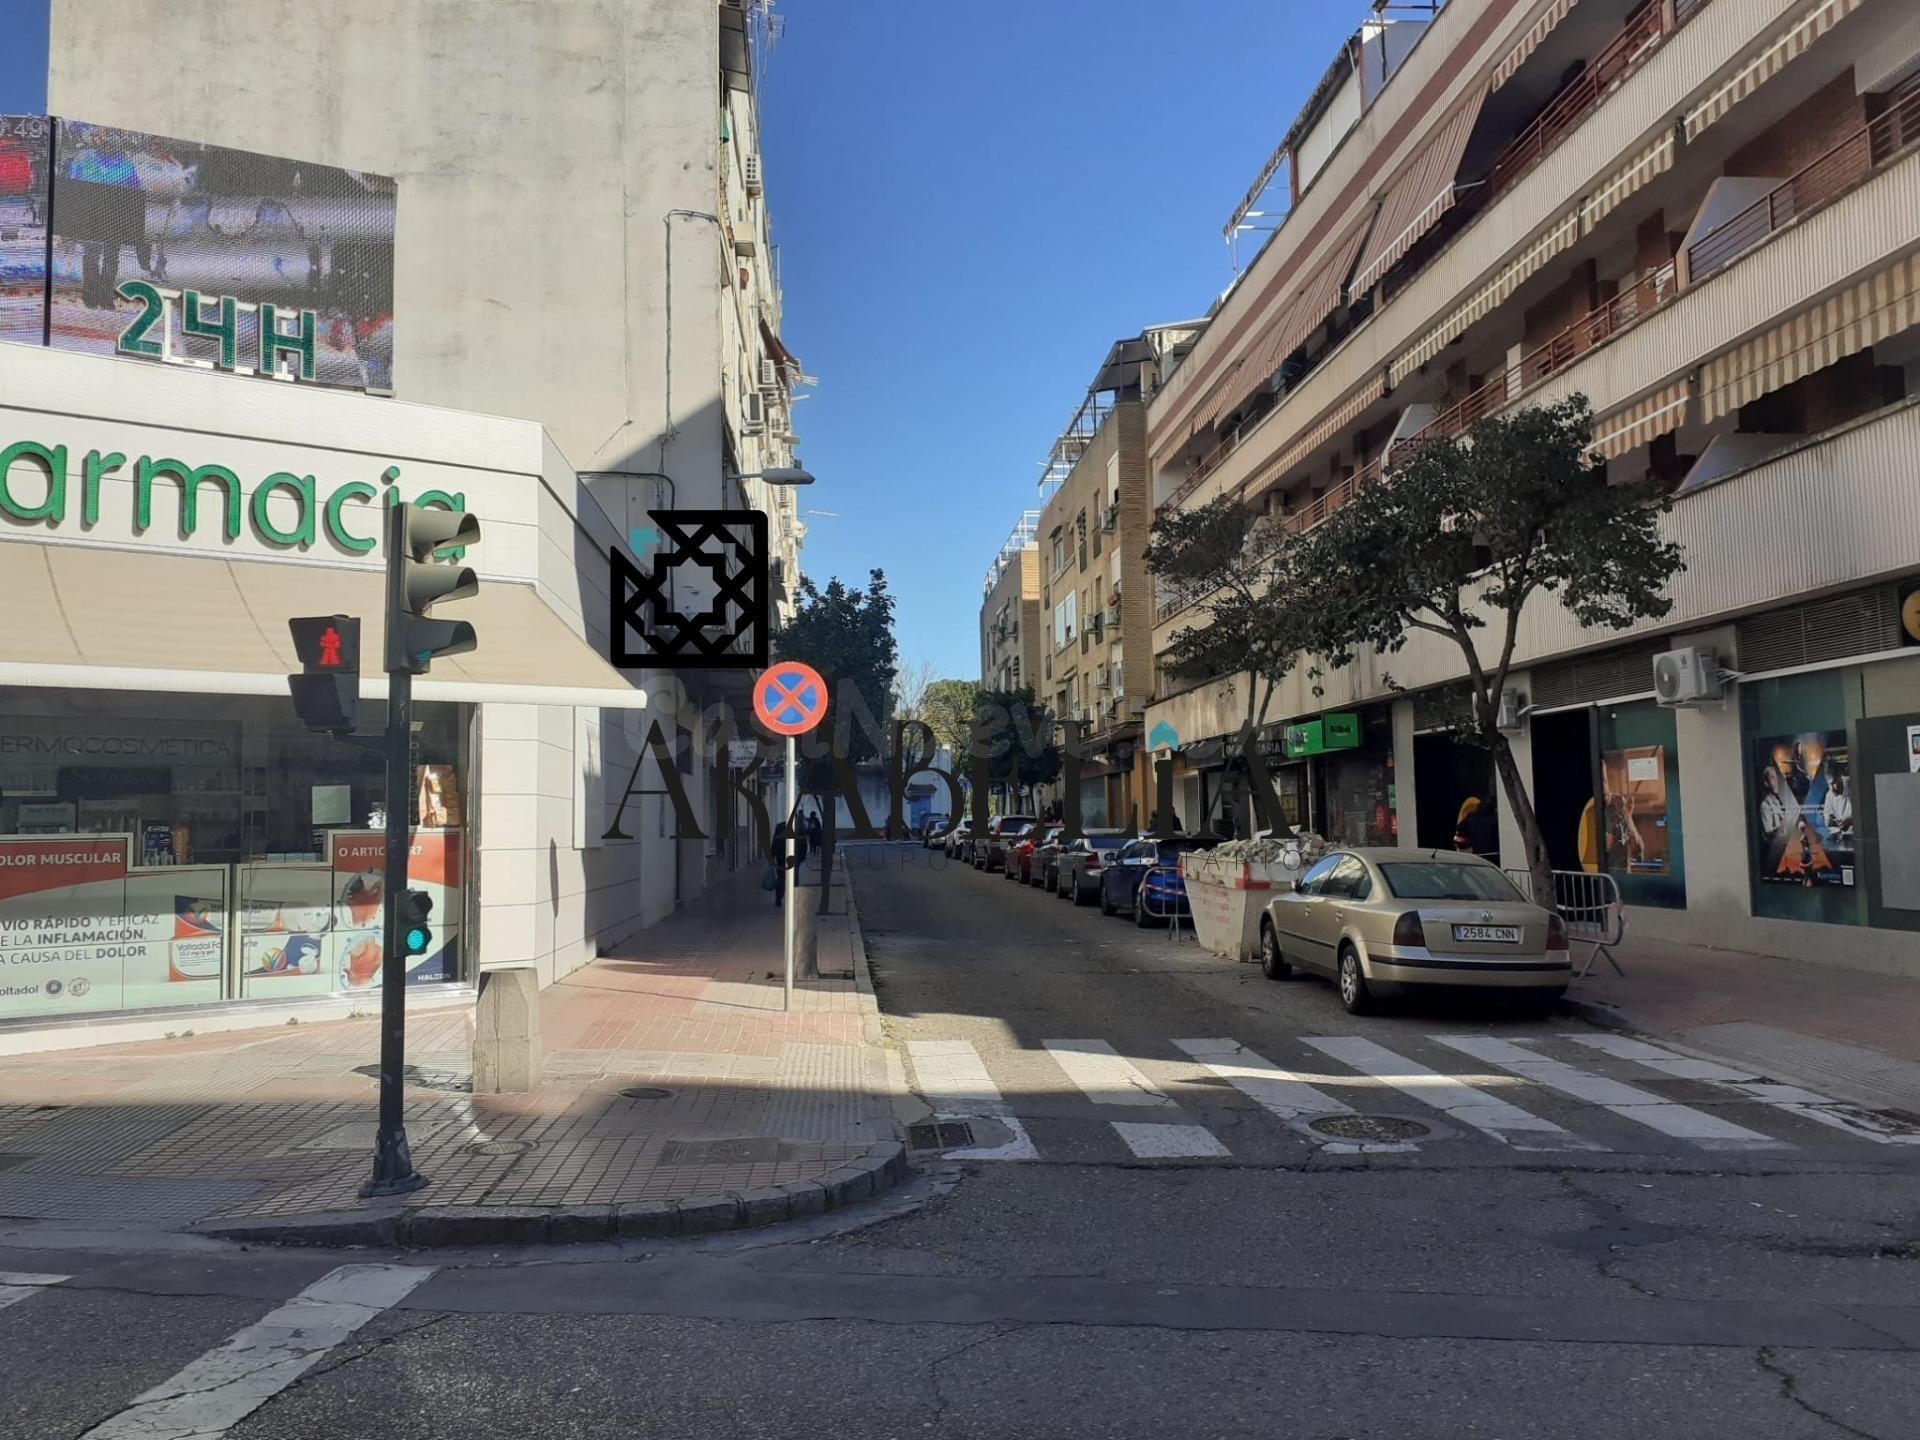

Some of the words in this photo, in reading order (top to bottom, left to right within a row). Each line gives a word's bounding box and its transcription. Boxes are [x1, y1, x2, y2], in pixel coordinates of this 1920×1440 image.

[115, 280, 316, 381] 24H
[40, 852, 121, 865] MUSCULAR
[33, 915, 91, 930] RÁPIDO
[94, 916, 103, 927] Y
[109, 913, 160, 927] EFICAZ
[14, 935, 33, 946] LA
[1463, 927, 1491, 938] 2584
[1495, 928, 1515, 939] CNN
[11, 951, 61, 964] CAUSA
[64, 950, 93, 961] DEL
[96, 945, 146, 959] DOLOR
